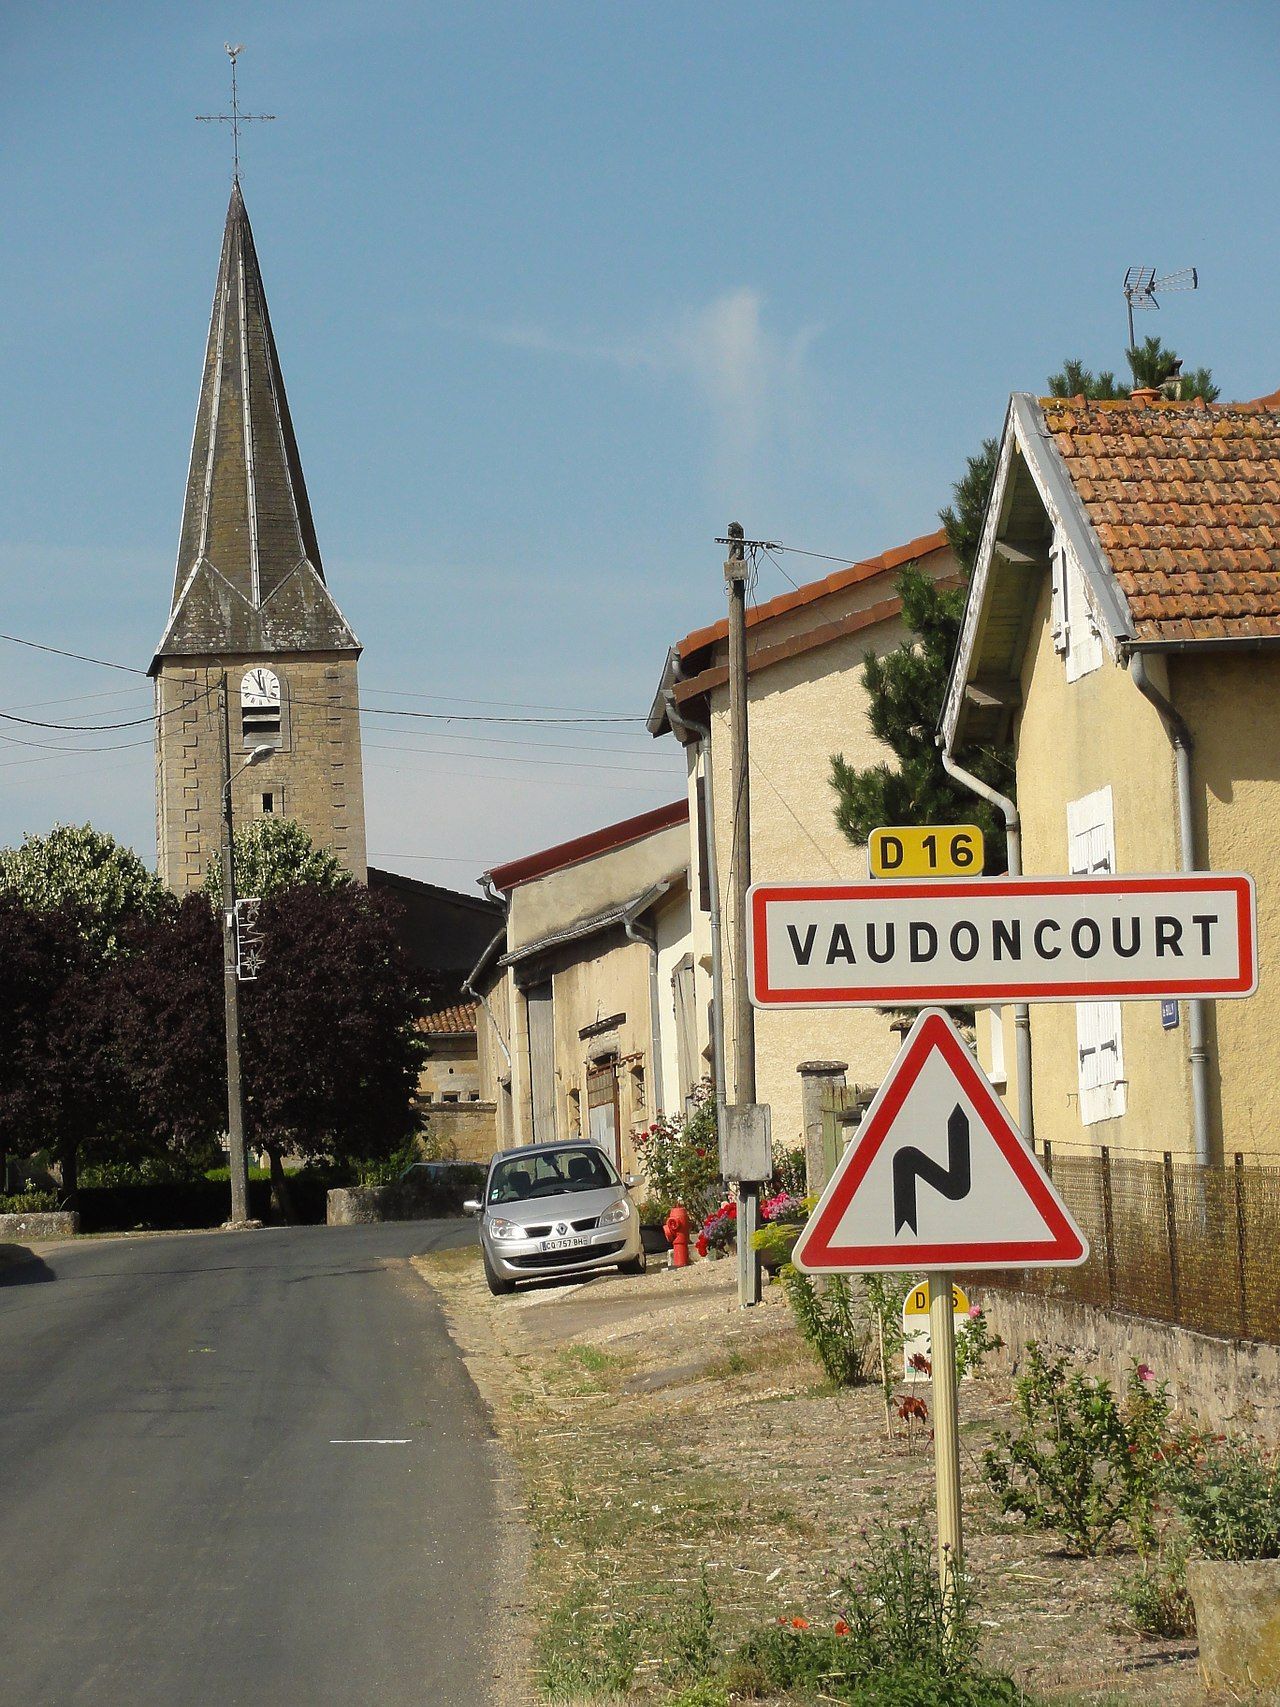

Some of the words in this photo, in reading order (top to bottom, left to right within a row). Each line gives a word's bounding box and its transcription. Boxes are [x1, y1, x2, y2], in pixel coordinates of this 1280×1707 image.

[880, 836, 904, 869] D
[922, 833, 974, 868] 16
[787, 915, 1219, 965] VAUDONCOURT
[916, 1292, 926, 1308] D
